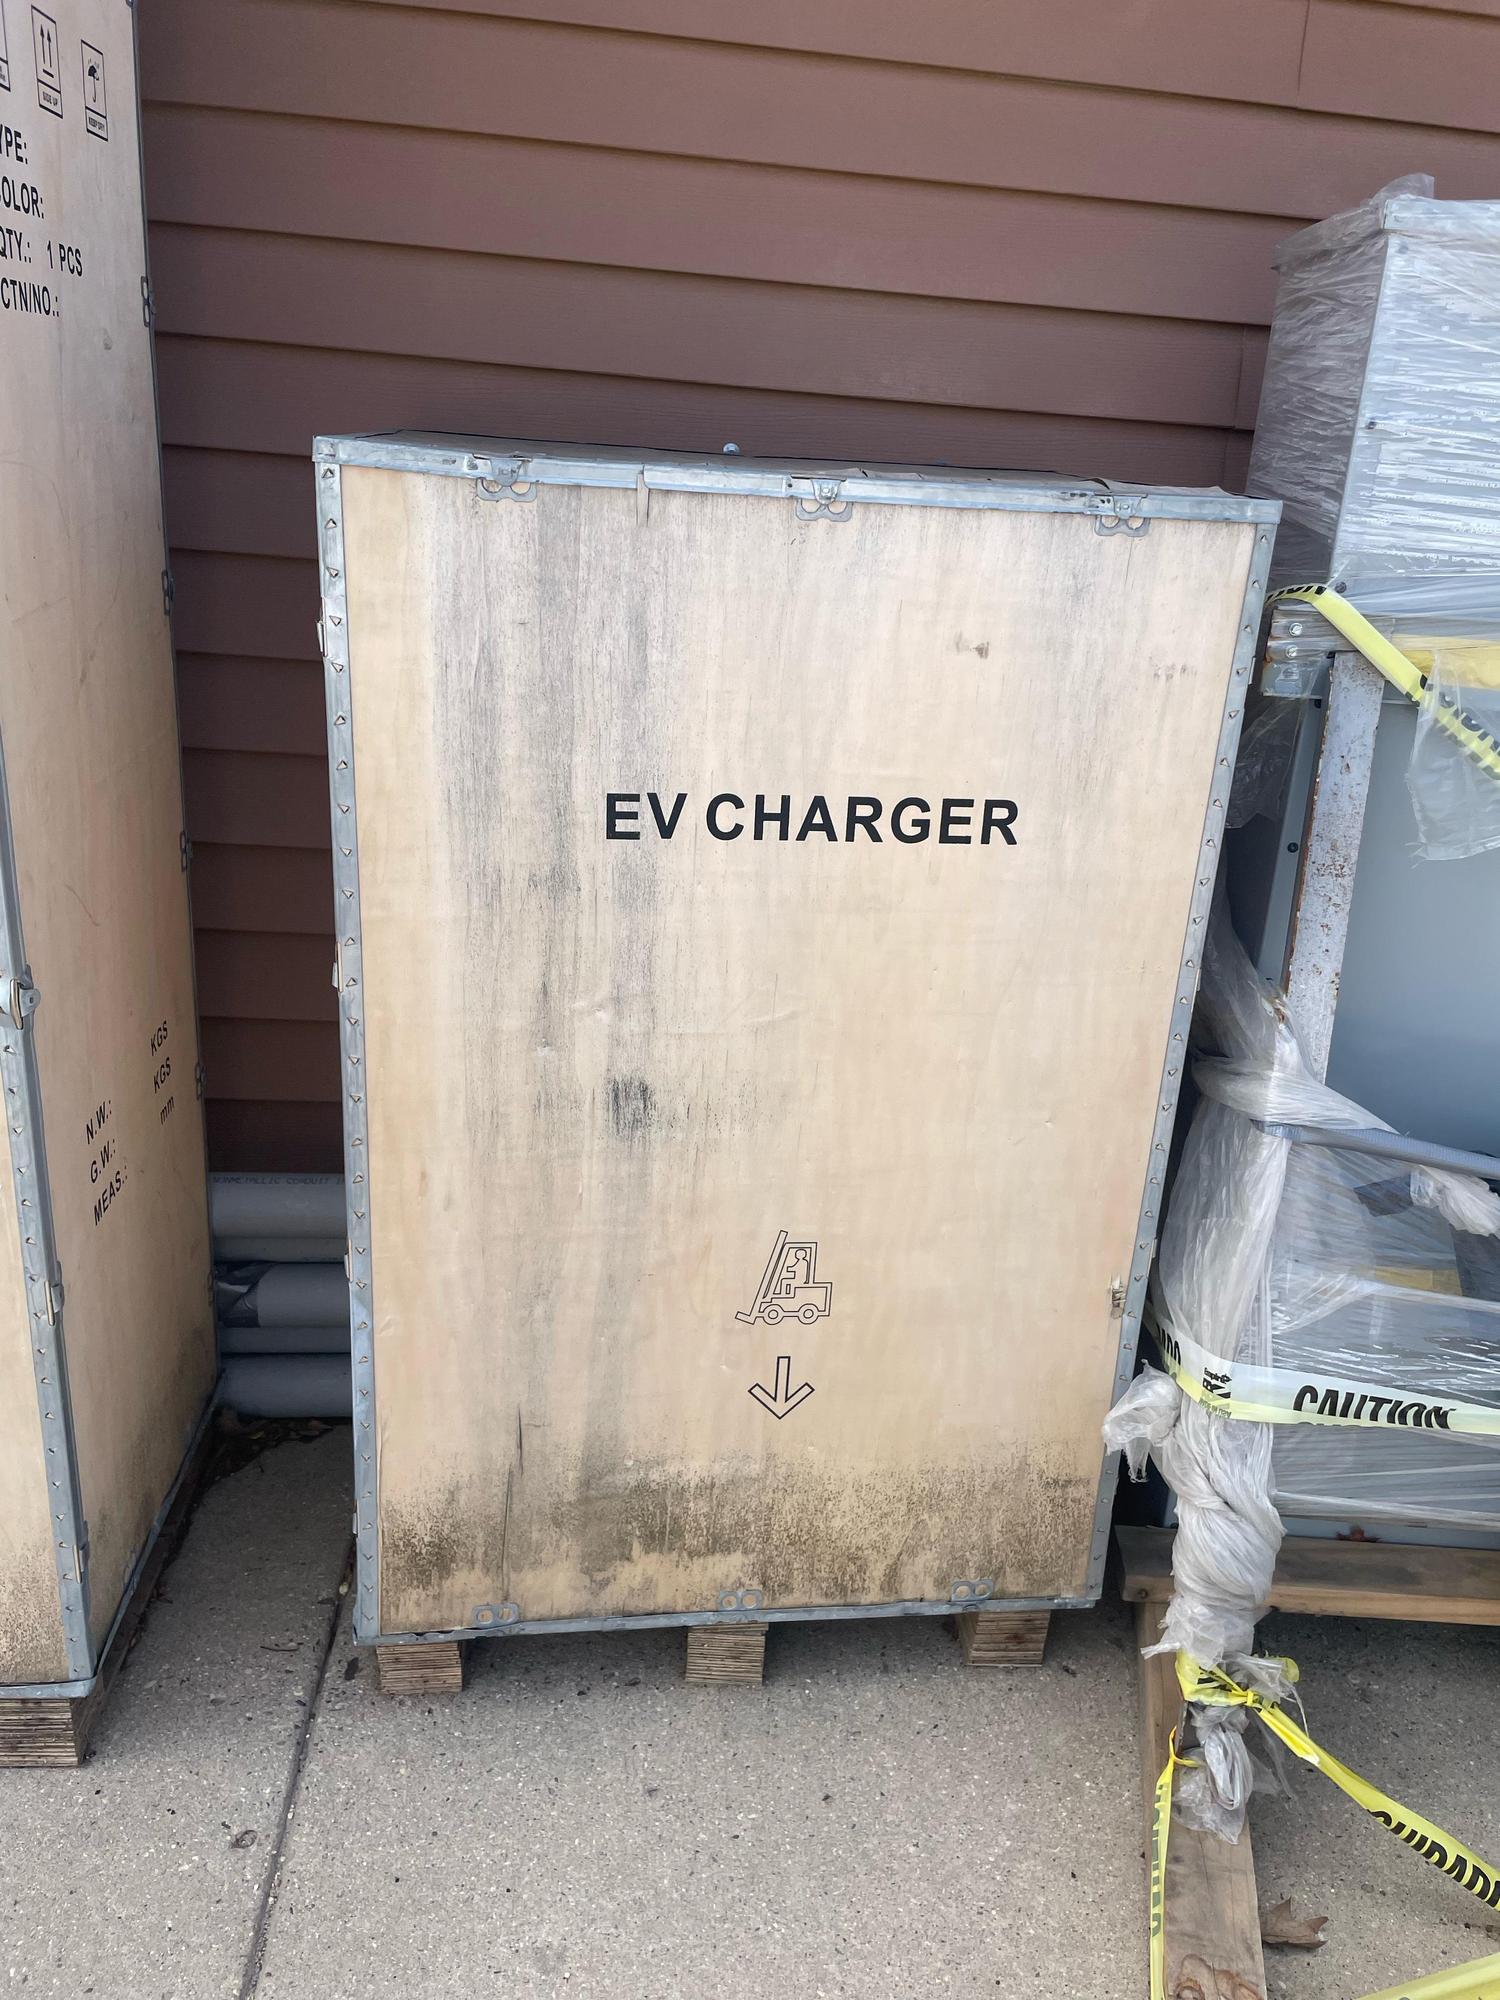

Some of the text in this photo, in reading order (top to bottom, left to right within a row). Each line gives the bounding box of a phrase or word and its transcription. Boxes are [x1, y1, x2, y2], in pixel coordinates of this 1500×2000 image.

[0, 176, 44, 219] OLOR:
[47, 240, 53, 269] 1
[59, 243, 82, 277] PCS
[606, 792, 1018, 845] EV CHARGER
[85, 1020, 168, 1144] N.W.: KGS
[90, 1056, 171, 1184] G.W.: KGS
[94, 1096, 175, 1226] MEAS.: mm
[1293, 1384, 1457, 1430] CAUTION
